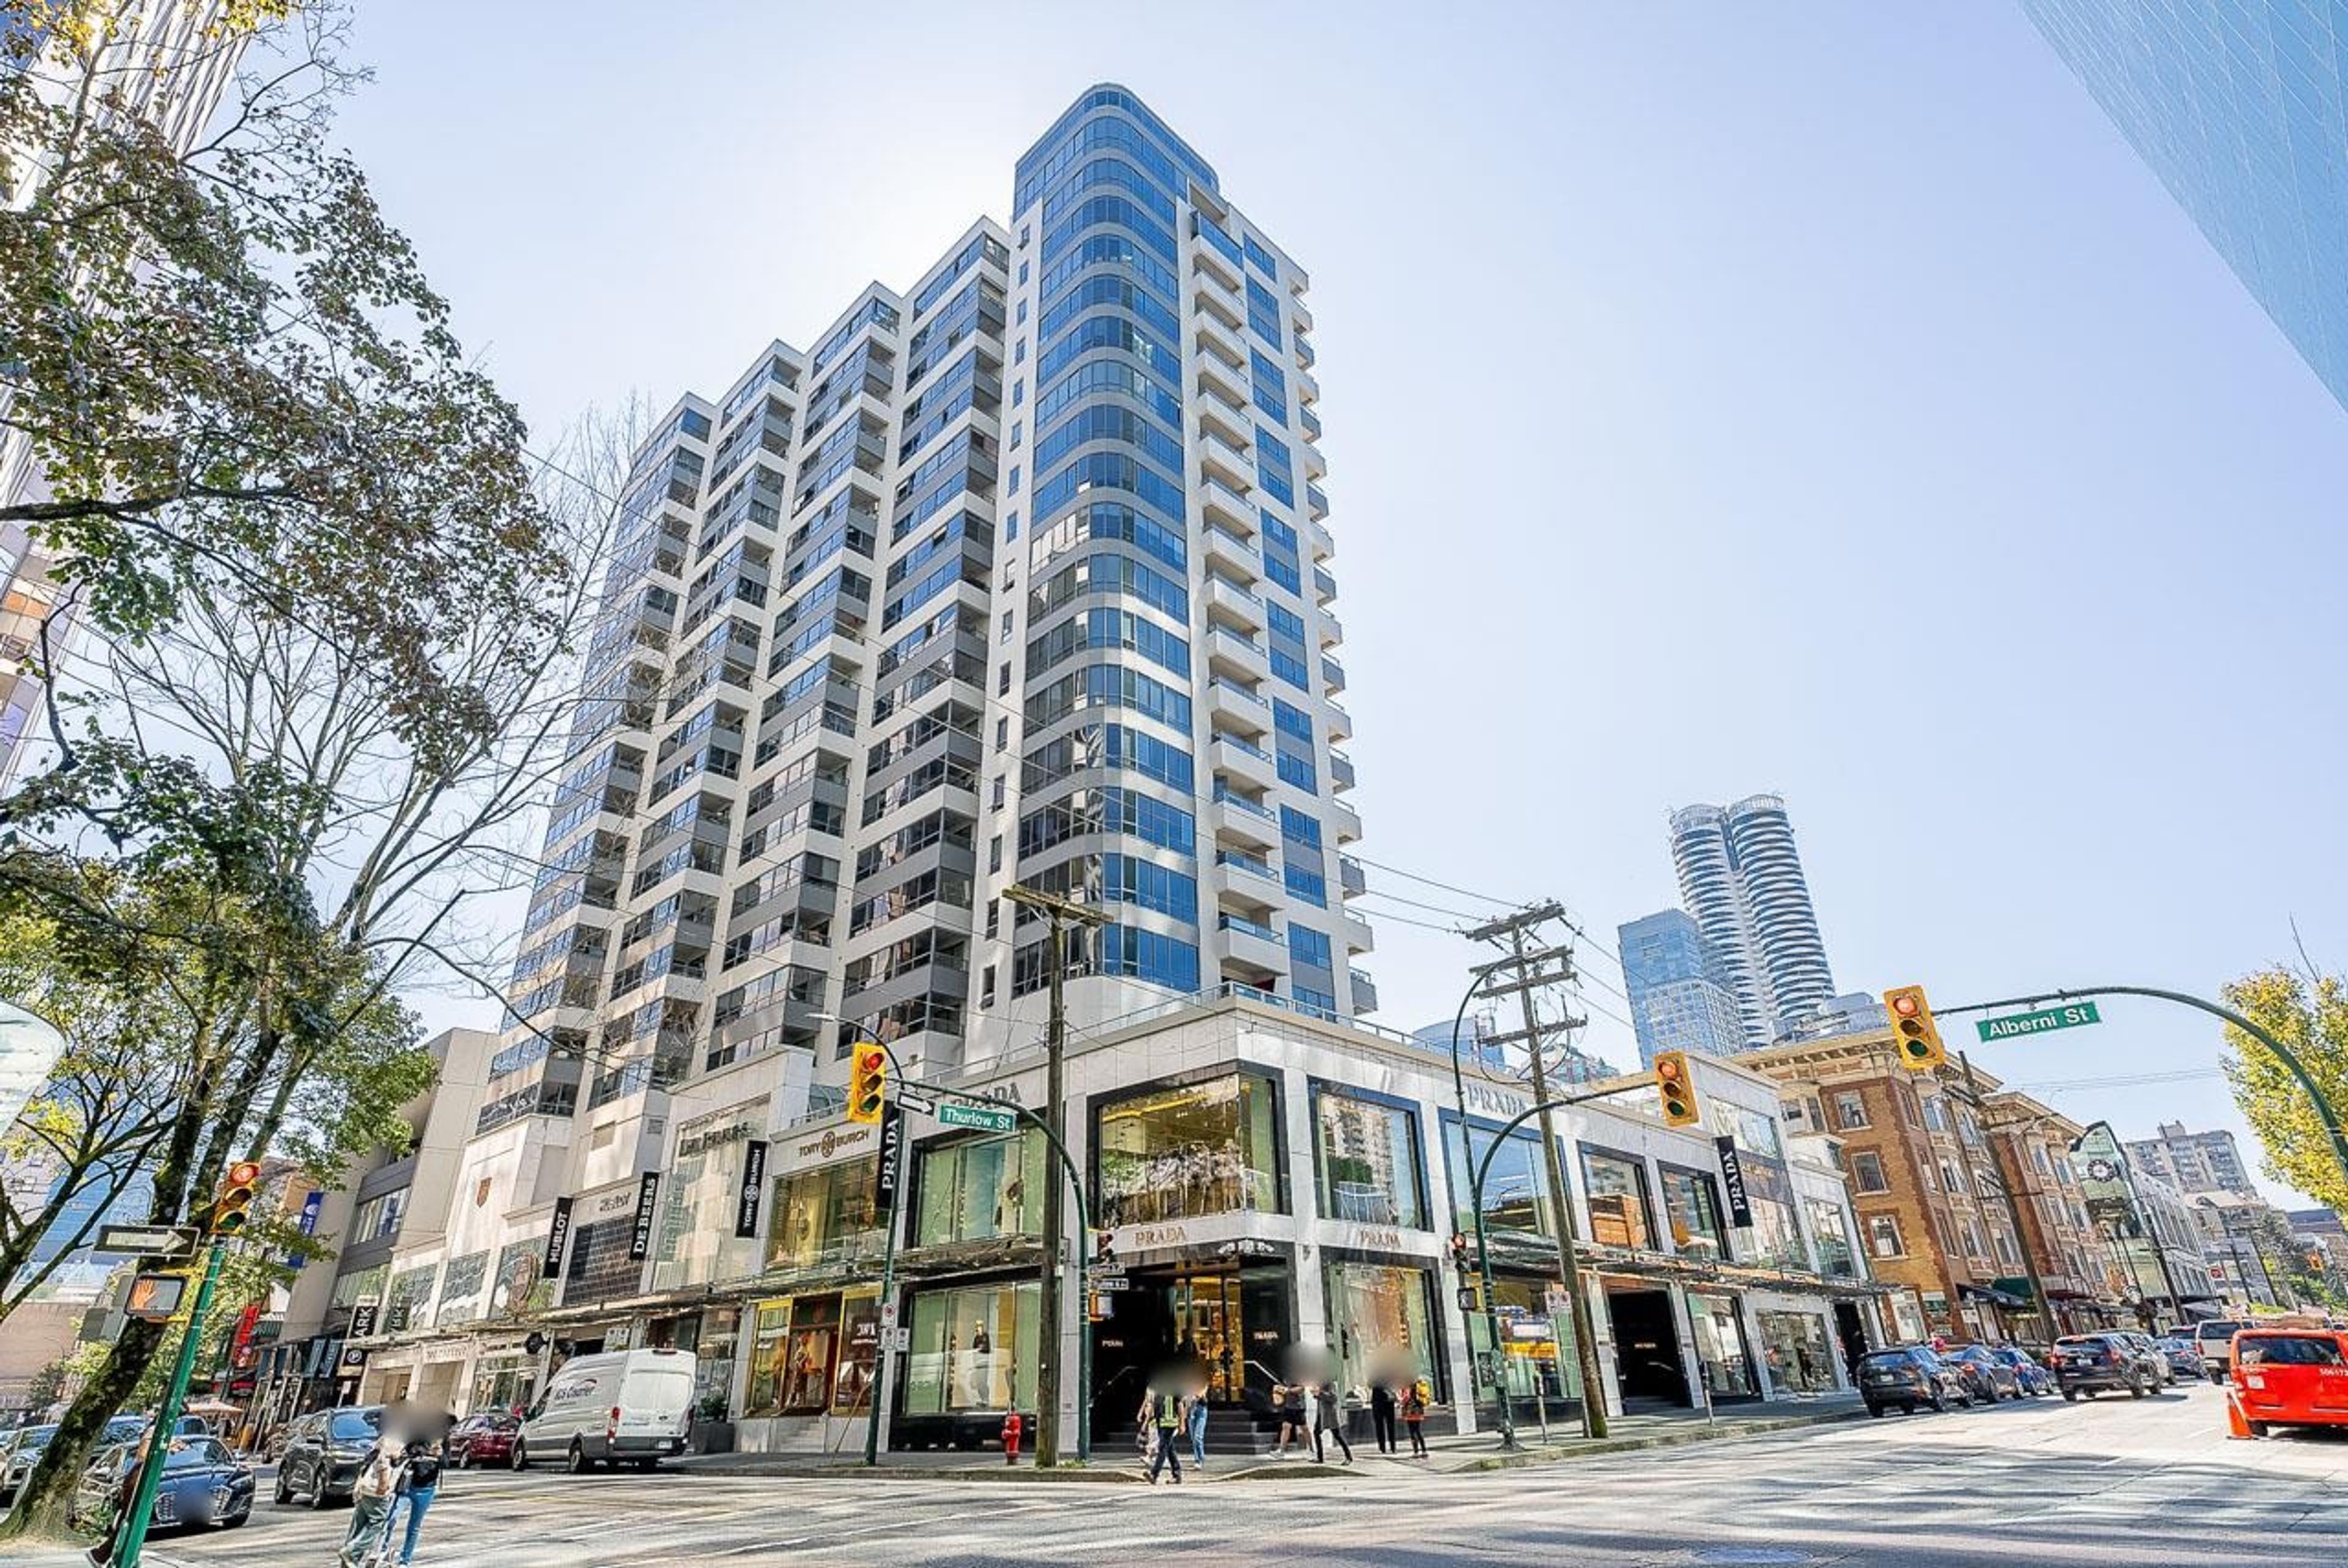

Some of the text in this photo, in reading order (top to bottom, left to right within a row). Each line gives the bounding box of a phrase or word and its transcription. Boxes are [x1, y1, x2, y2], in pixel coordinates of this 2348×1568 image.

[1990, 1008, 2089, 1037] Alberni St
[945, 1108, 1011, 1129] Thurlow St
[799, 1129, 869, 1157] TORY BURCH
[882, 1118, 898, 1190] PRADA
[743, 1149, 761, 1228] TORY BURCH
[1723, 1150, 1746, 1210] PRADA
[633, 1178, 656, 1254] DE BEERS
[548, 1212, 568, 1264] HUBLOT
[1135, 1226, 1187, 1246] PRADA
[1360, 1230, 1401, 1248] PRADA
[353, 1307, 374, 1338] ARK
